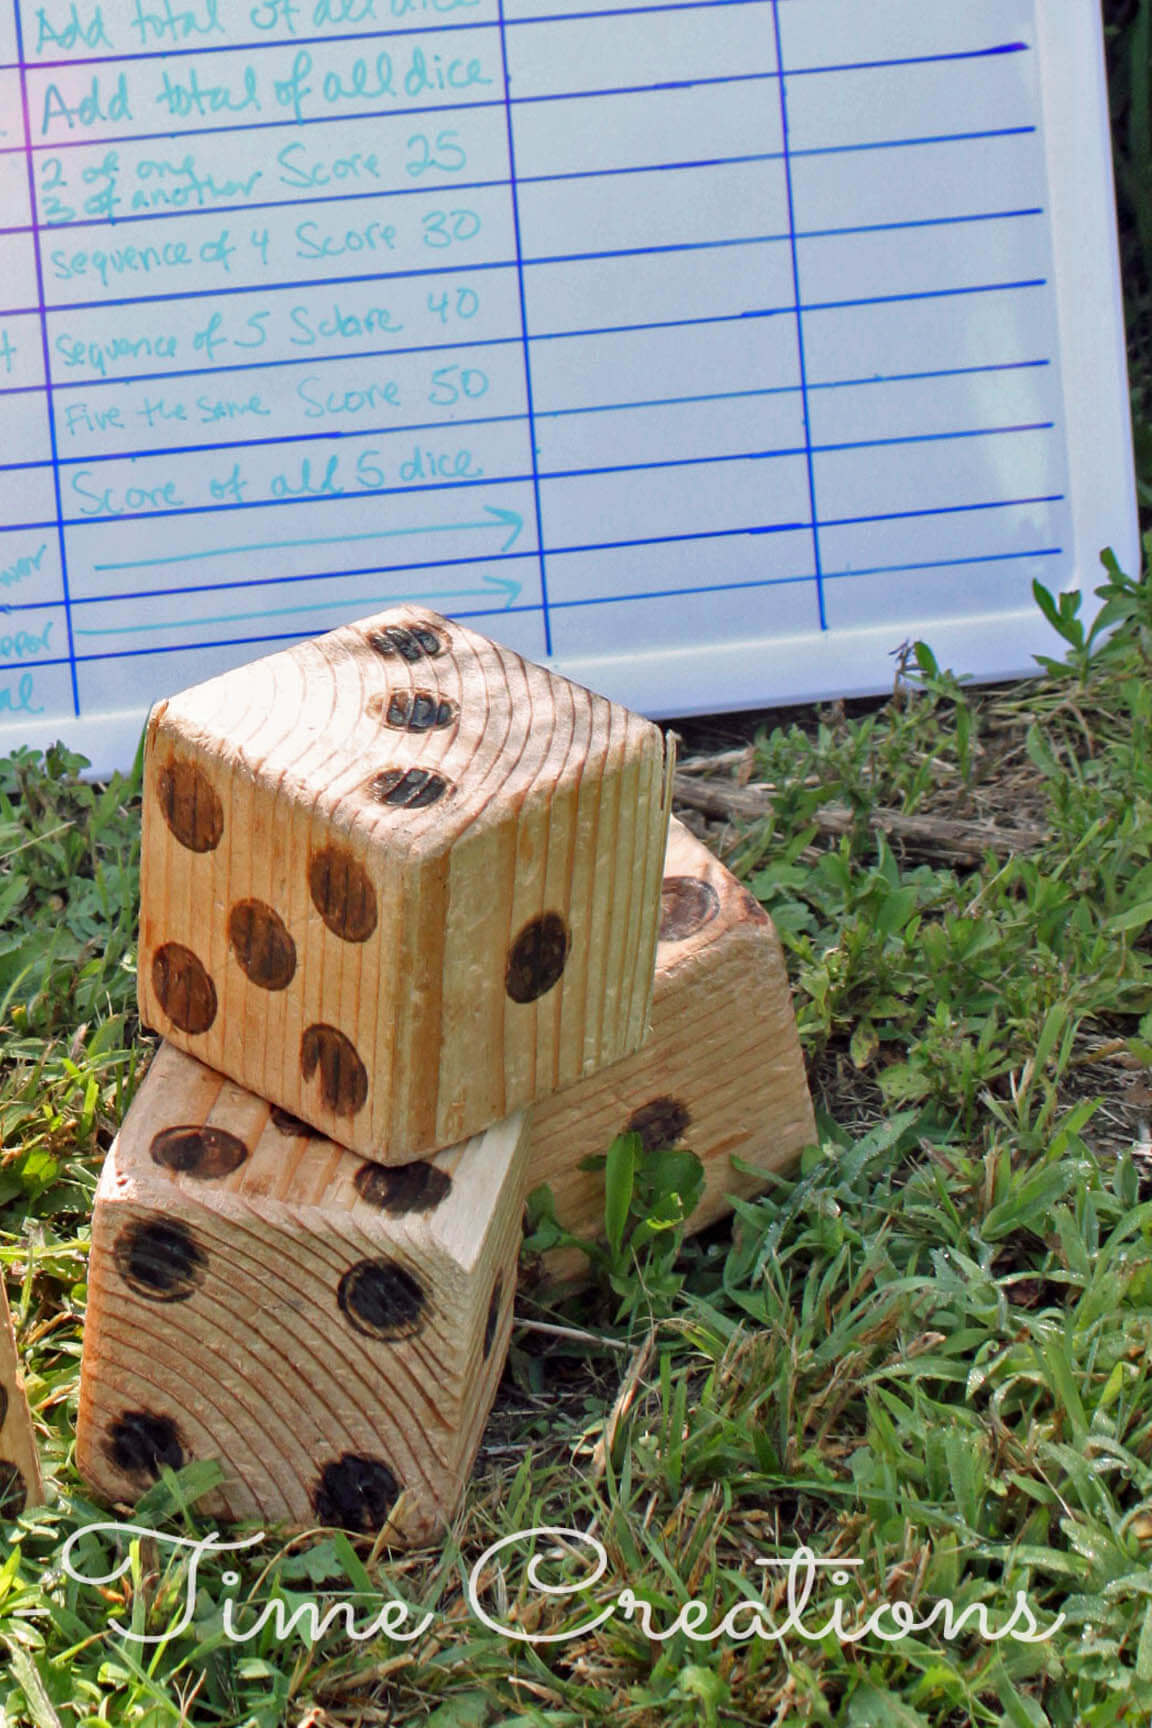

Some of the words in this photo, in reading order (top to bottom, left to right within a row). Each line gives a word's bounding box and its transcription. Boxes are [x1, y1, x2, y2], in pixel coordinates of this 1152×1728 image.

[35, 2, 114, 54] Add
[42, 72, 133, 135] Add
[156, 65, 262, 117] total
[274, 50, 312, 125] of
[323, 51, 397, 102] all
[405, 46, 493, 96] dice
[41, 157, 67, 191] 2
[278, 140, 380, 188] Score
[405, 130, 467, 177] 25
[199, 230, 237, 272] of
[251, 229, 269, 265] 4
[296, 221, 396, 259] Score
[422, 209, 482, 249] 30
[193, 312, 227, 360] of
[234, 311, 270, 347] 5
[427, 287, 480, 324] 40
[65, 403, 125, 435] Five
[297, 376, 401, 418] Score
[428, 364, 490, 406] 50
[72, 470, 185, 515] Score
[210, 464, 248, 504] of
[271, 455, 344, 497] all
[356, 450, 385, 489] 5
[400, 447, 484, 482] dice
